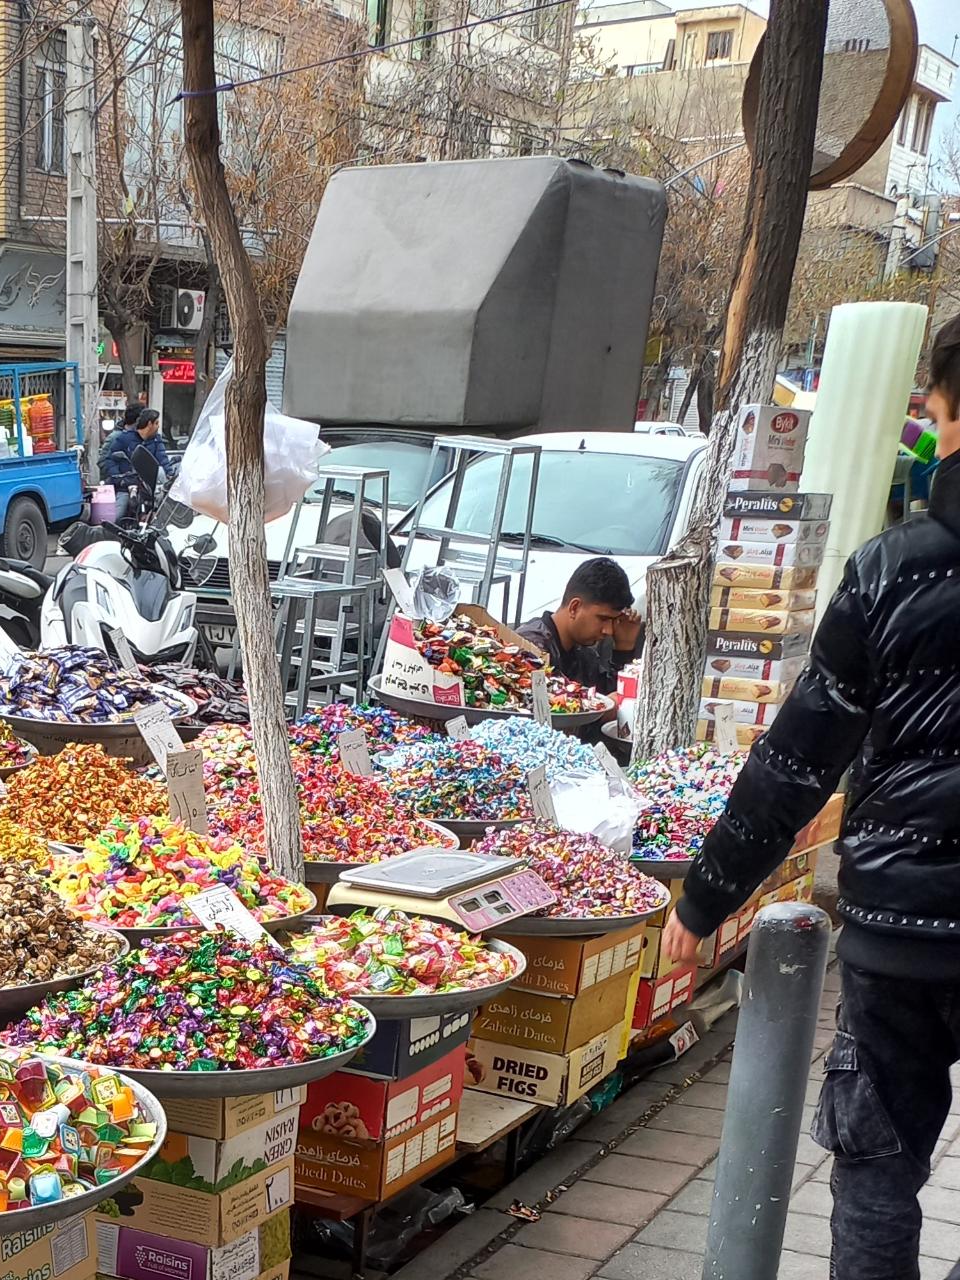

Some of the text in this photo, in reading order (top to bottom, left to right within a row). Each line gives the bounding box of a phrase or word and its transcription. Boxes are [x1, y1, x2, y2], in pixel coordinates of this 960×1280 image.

[536, 974, 570, 992] Dates
[480, 1016, 556, 1045] Zahedi Dates
[492, 1056, 549, 1081] DRIED
[497, 1076, 538, 1098] FIGS
[265, 1116, 295, 1146] RAISIN
[264, 1137, 293, 1164] GREEN
[295, 1163, 367, 1190] ahedi Dates
[148, 1251, 189, 1270] Raisins
